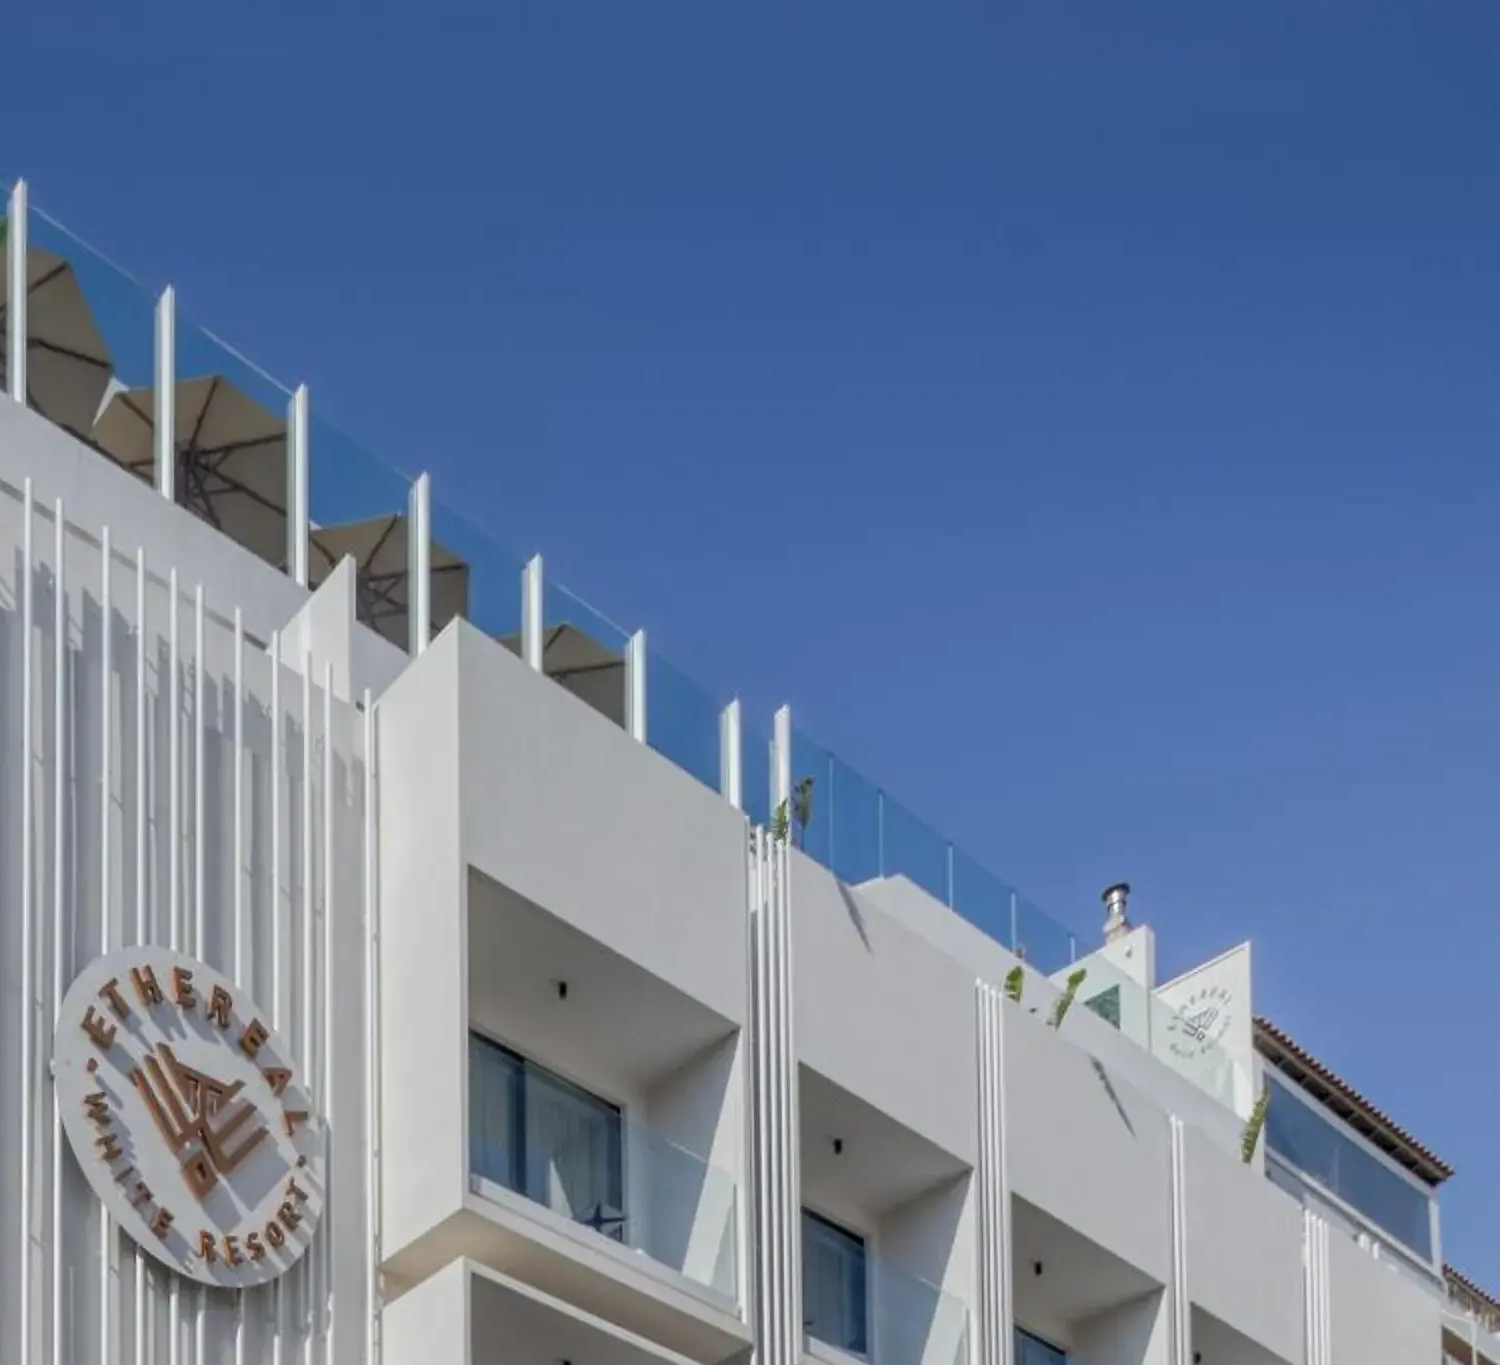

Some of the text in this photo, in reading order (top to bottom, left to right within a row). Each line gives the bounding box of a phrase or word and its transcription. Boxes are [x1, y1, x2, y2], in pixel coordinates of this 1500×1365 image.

[80, 964, 309, 1136] ETHEREAL
[83, 1090, 310, 1268] WHITE RESORT
